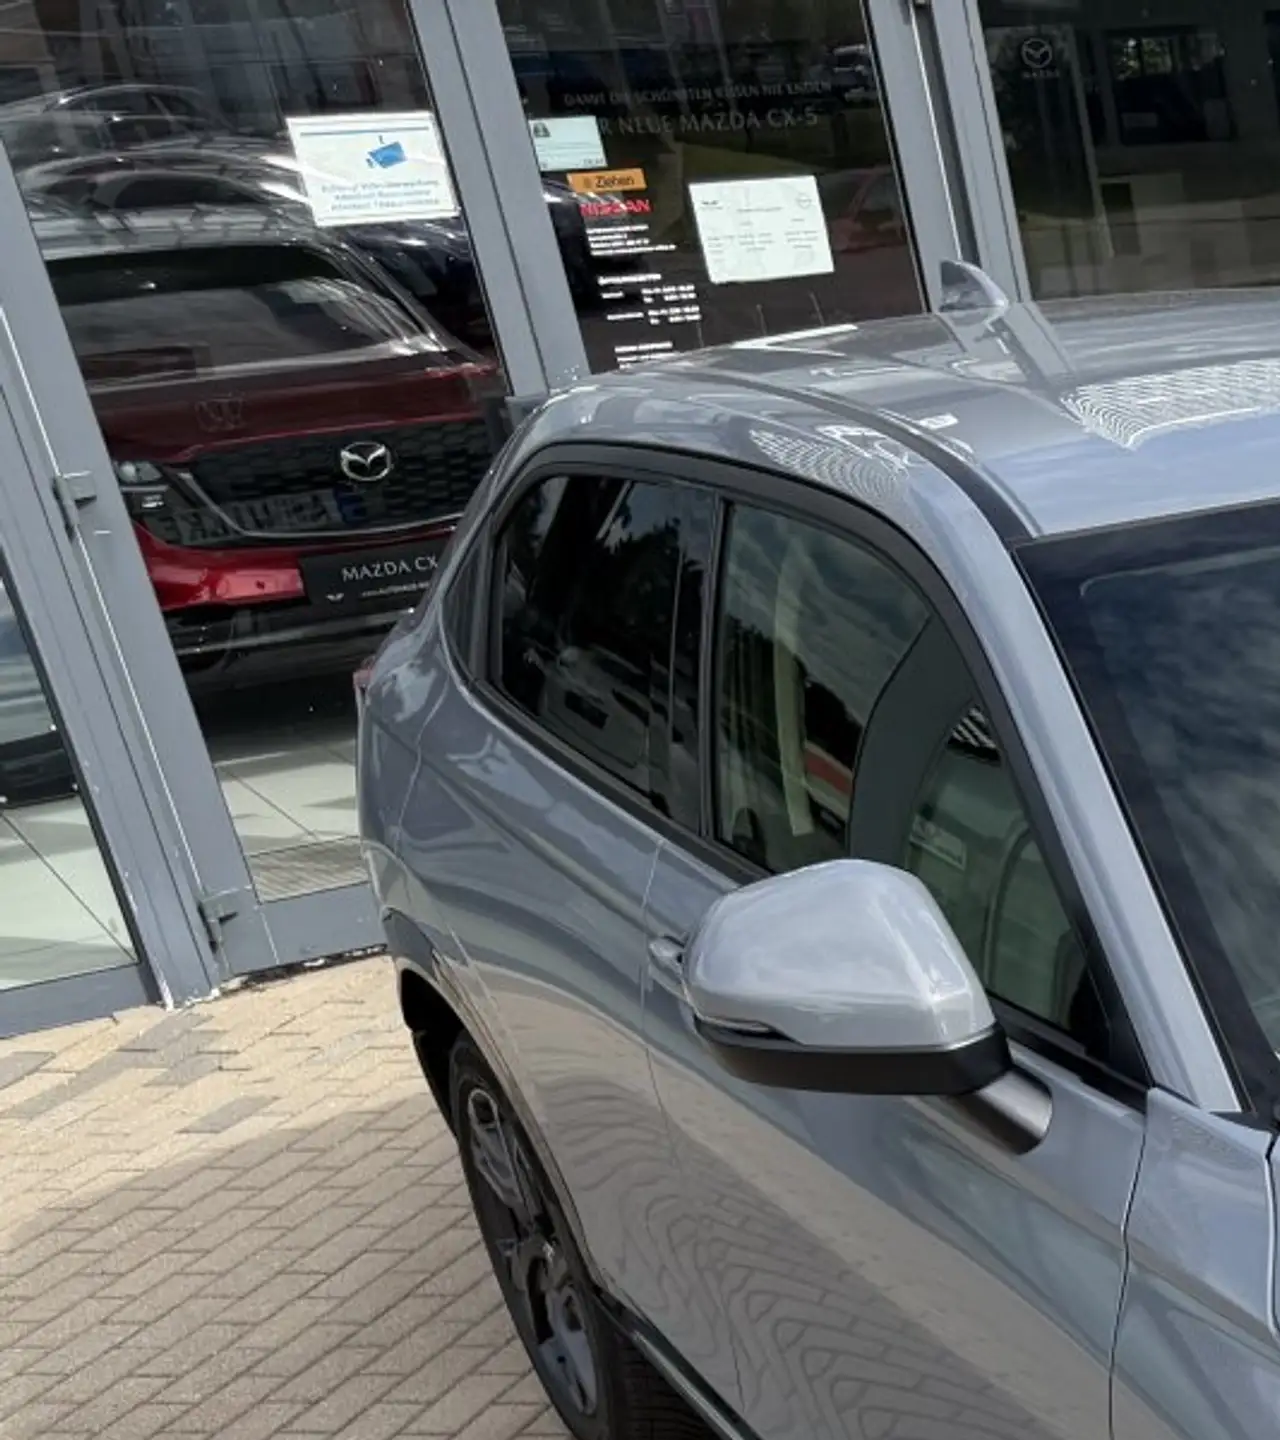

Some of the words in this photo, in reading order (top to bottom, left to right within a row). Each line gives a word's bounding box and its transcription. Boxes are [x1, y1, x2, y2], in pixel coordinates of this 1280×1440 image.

[680, 108, 761, 133] MAZDA
[766, 104, 819, 129] CX-5
[341, 559, 412, 582] MAZDA
